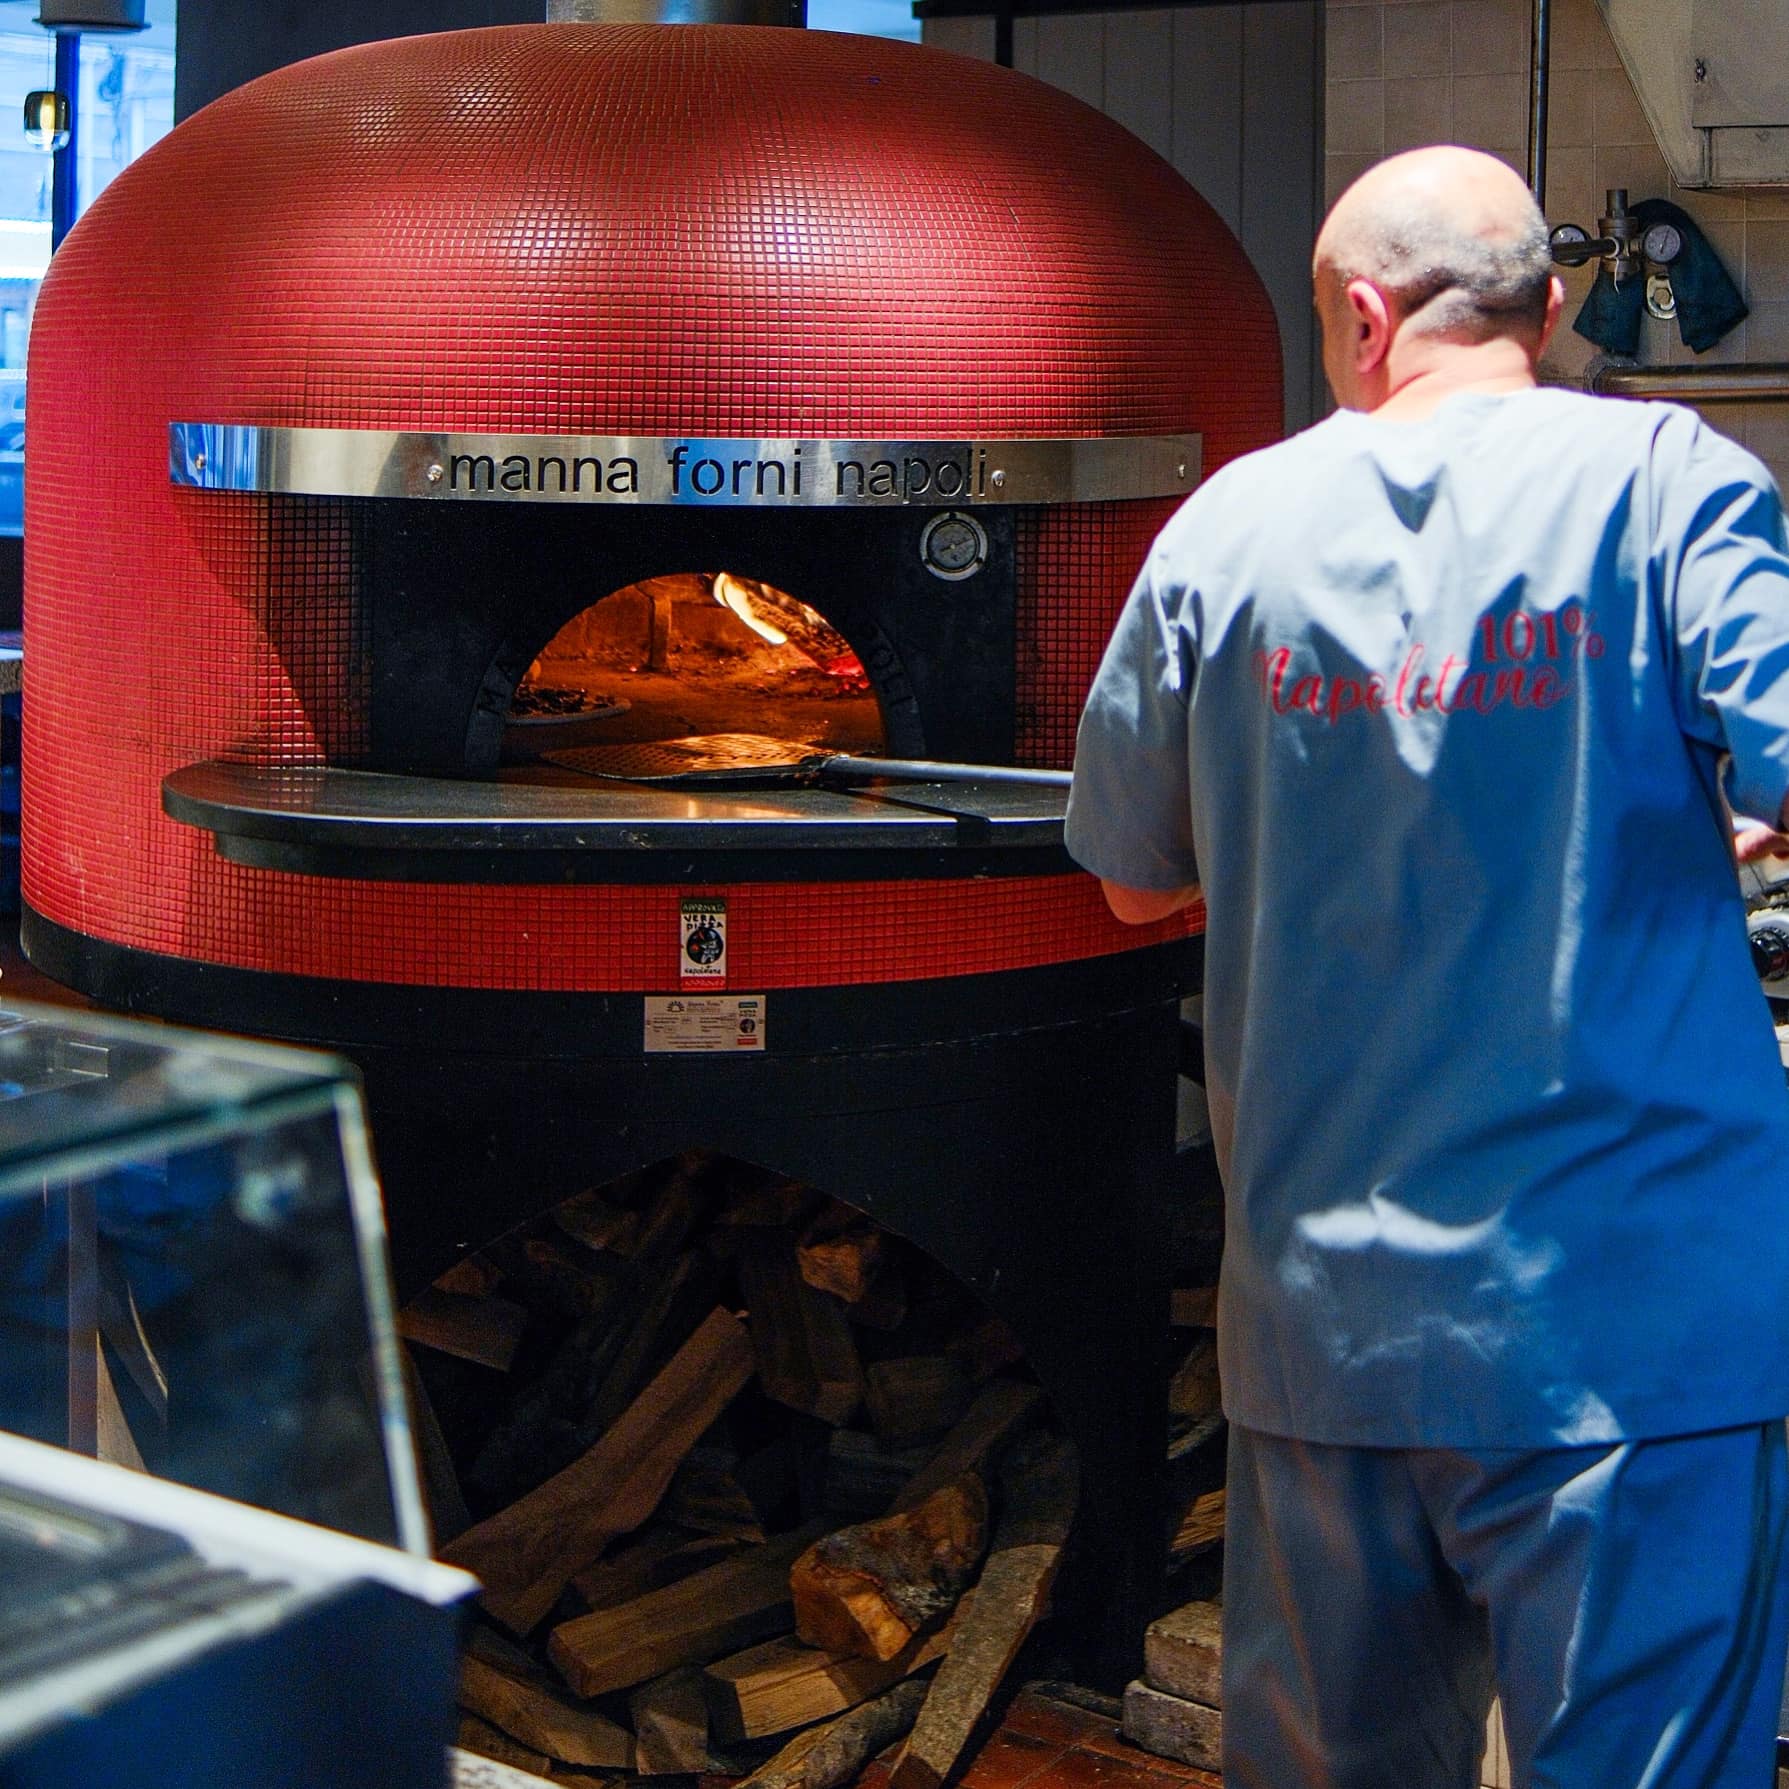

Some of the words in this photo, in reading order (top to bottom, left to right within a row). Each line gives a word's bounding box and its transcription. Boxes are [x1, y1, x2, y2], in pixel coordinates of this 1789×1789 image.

[449, 454, 639, 494] manna
[668, 446, 801, 496] forni
[836, 448, 987, 505] napoli
[1478, 607, 1605, 662] 101%
[683, 914, 716, 923] VERA
